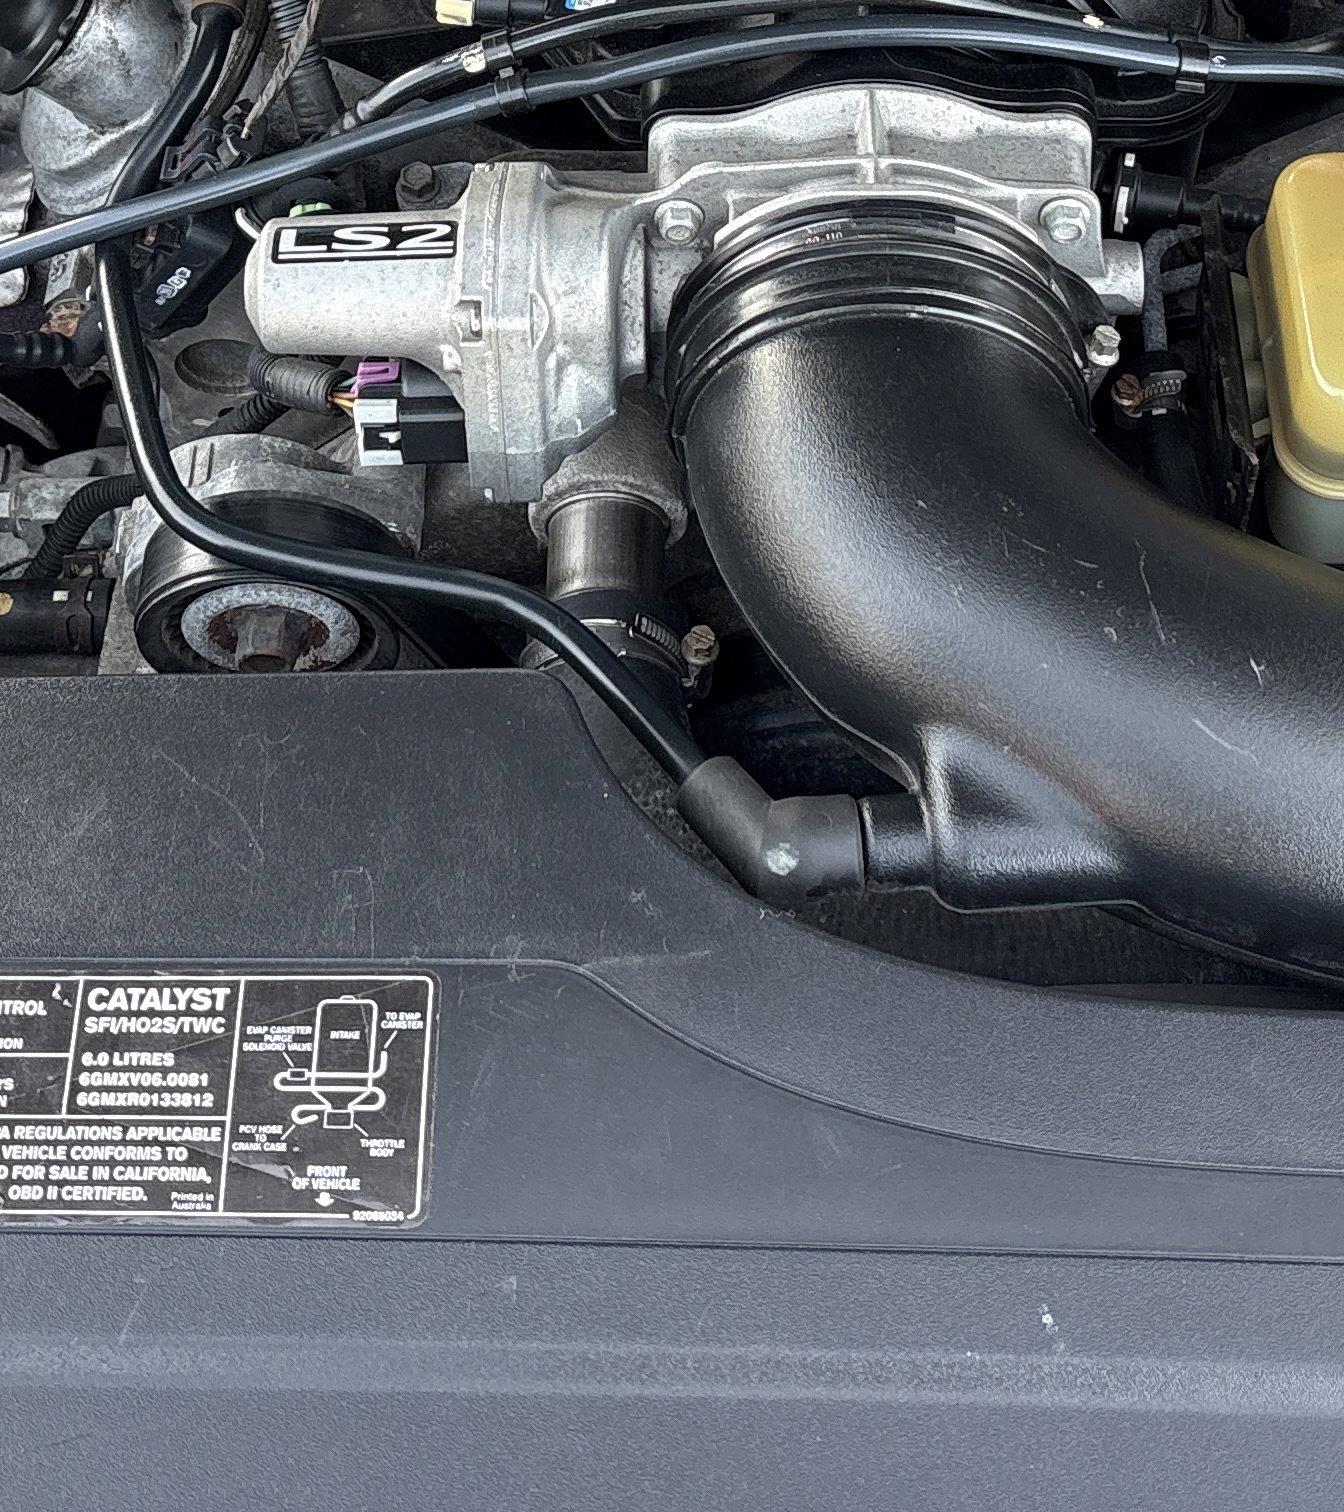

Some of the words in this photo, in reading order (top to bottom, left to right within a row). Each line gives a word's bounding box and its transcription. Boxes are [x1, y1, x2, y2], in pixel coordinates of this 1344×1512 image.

[278, 223, 455, 253] LS2
[87, 987, 230, 1011] CATALYST
[84, 1016, 226, 1034] SFI/HO2S/TWC
[82, 1052, 109, 1066] 6.0
[113, 1052, 175, 1066] LITRES
[13, 1125, 123, 1140] REGULATIONS
[126, 1126, 221, 1141] APPLICABLE
[2, 1145, 67, 1160] VEHICLE
[70, 1146, 163, 1161] CONFORMS
[166, 1147, 188, 1161] TO
[12, 1165, 46, 1180] FOR
[48, 1165, 89, 1180] SALE
[92, 1166, 110, 1180] IN
[113, 1166, 212, 1184] CALIFORNIA,
[307, 1165, 348, 1178] FRONT
[292, 1178, 312, 1189] OF
[313, 1178, 361, 1190] VEHICLE
[8, 1185, 43, 1200] OBD
[61, 1186, 148, 1201] CERTIFIED.
[171, 1192, 202, 1202] Printed
[204, 1192, 214, 1202] in
